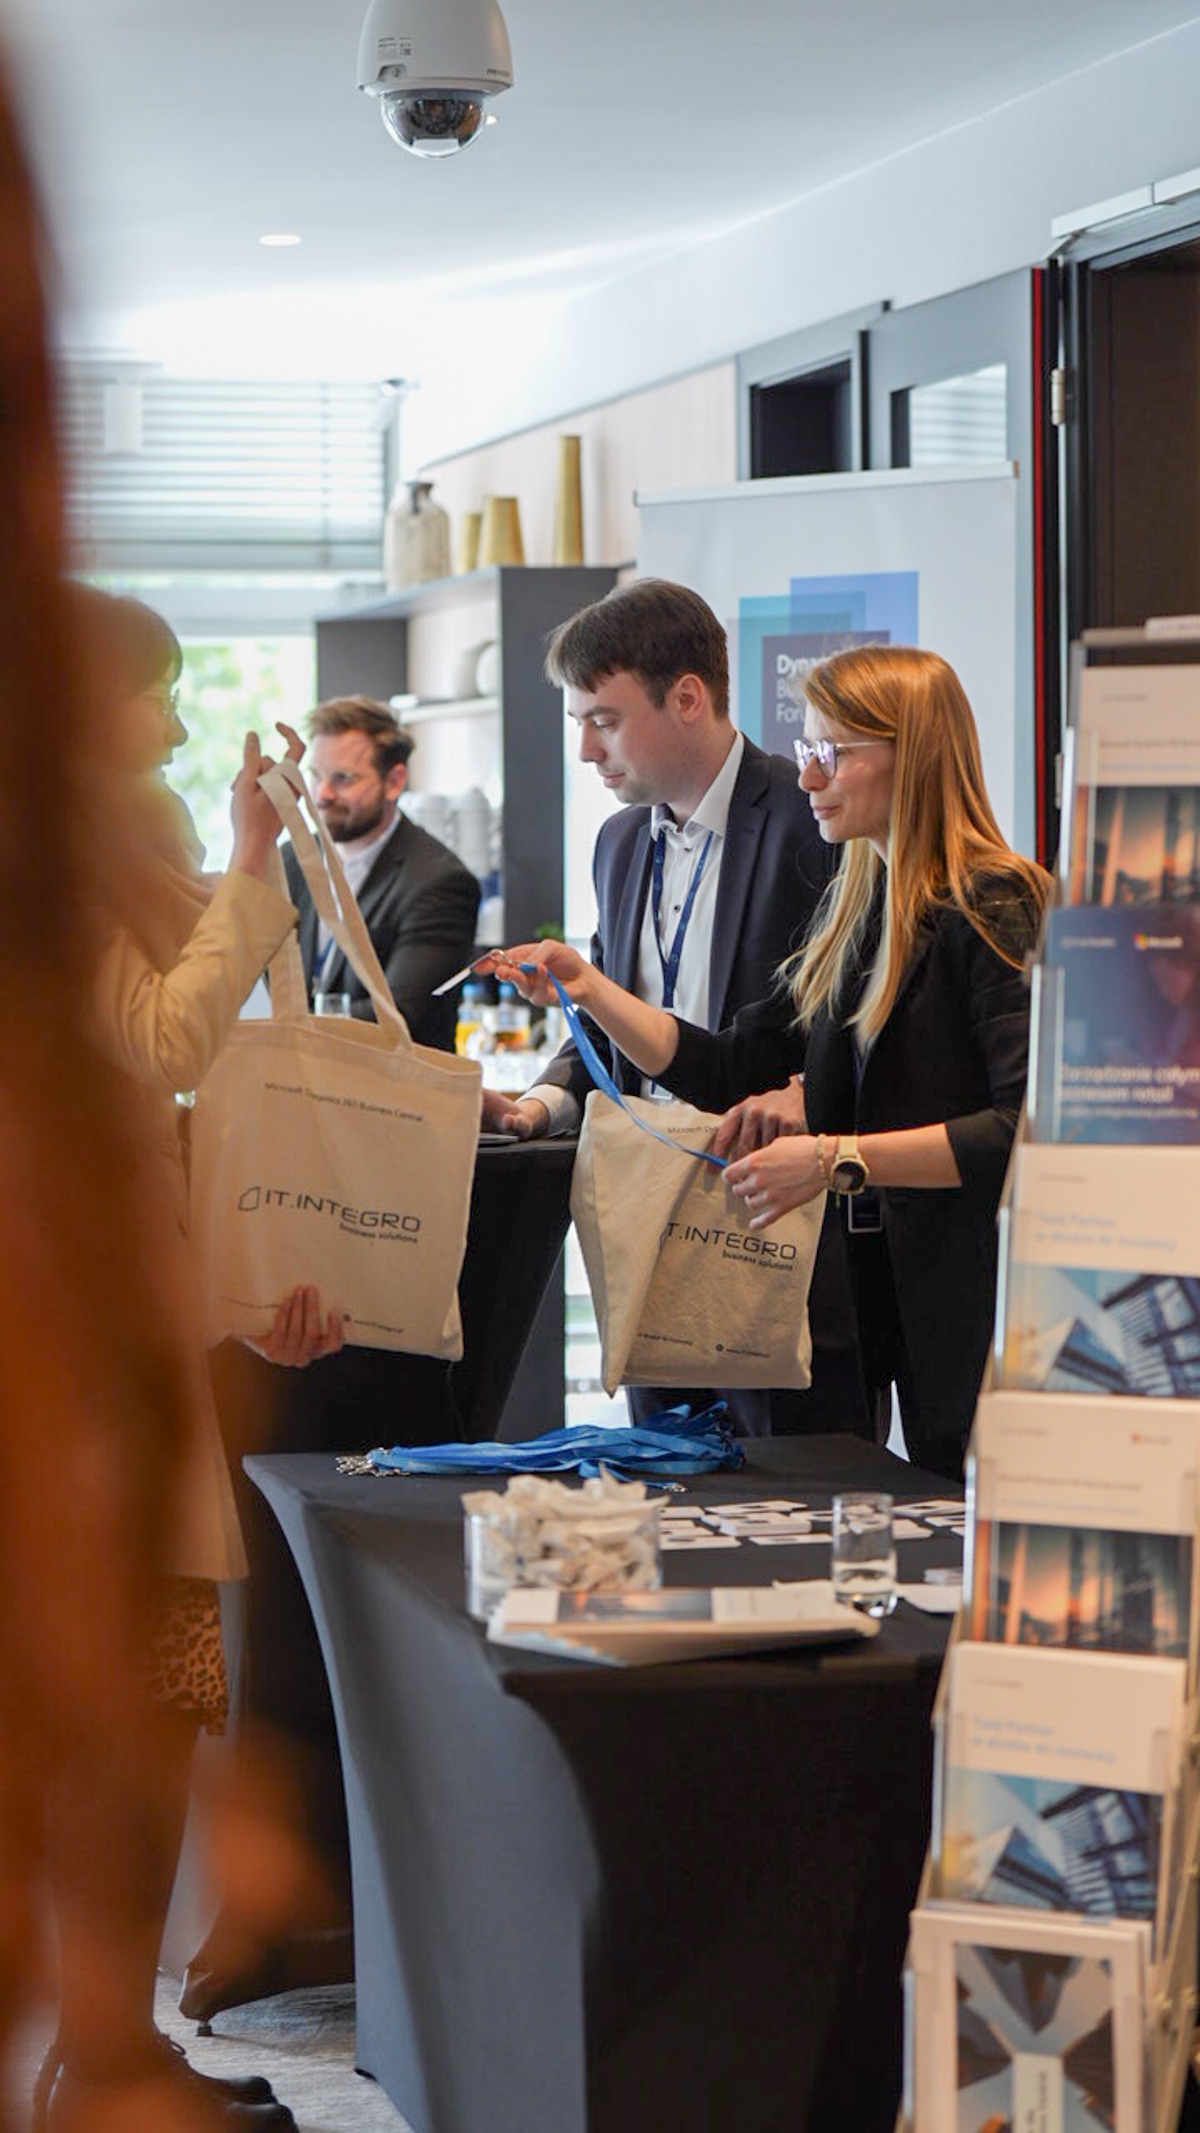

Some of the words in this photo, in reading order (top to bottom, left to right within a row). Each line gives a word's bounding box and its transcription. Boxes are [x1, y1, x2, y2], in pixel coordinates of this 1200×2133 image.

[776, 654, 819, 678] Dyn
[265, 1189, 421, 1233] IT.INTEGRO
[667, 1222, 797, 1260] T.INTEGRO
[723, 1250, 756, 1264] business
[758, 1258, 793, 1271] solutions
